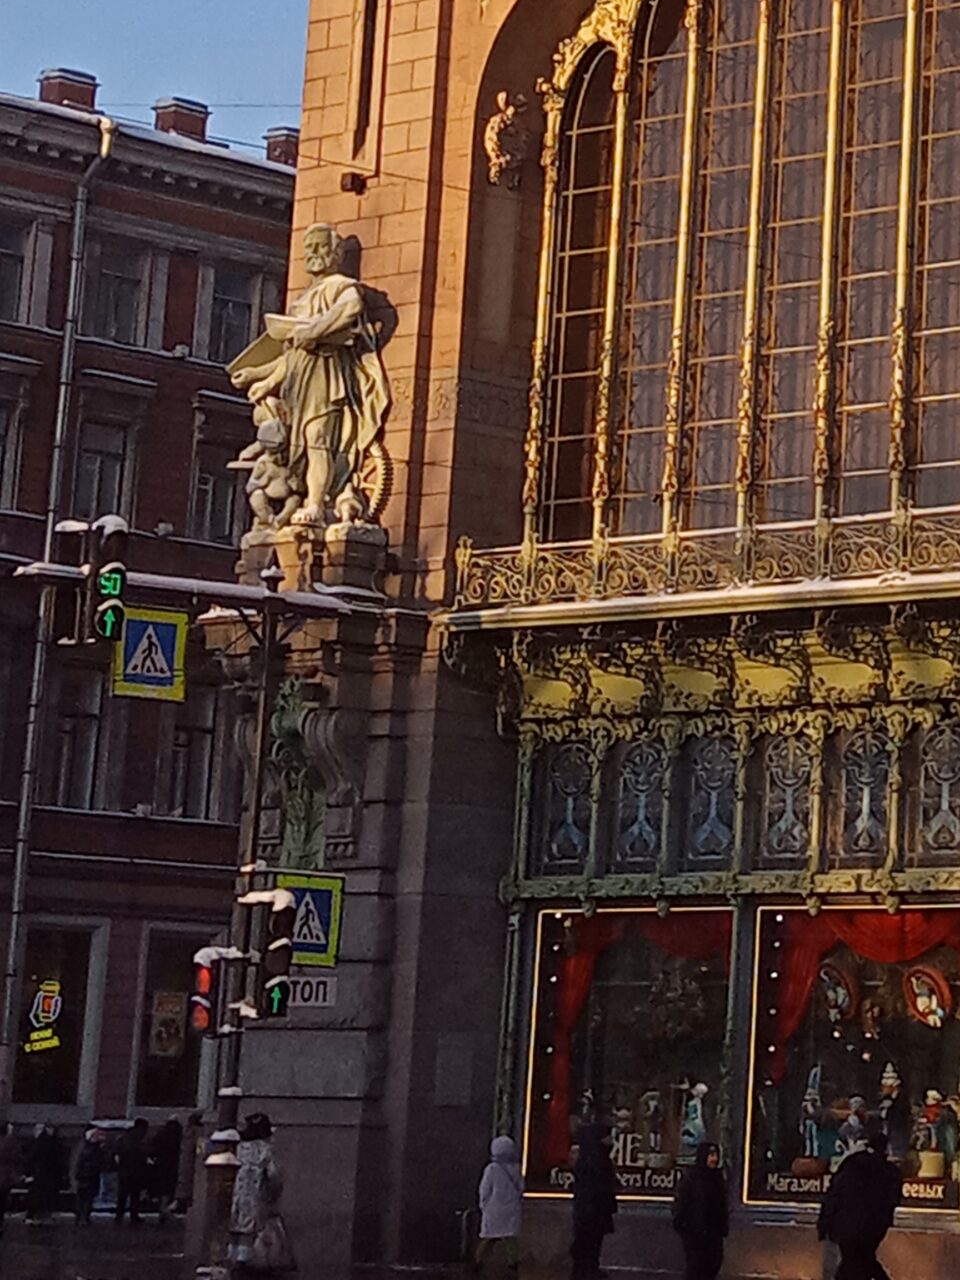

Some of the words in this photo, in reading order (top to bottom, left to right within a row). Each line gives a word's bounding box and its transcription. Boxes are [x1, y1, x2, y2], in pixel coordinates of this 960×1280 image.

[290, 980, 328, 1003] ТОП
[767, 1173, 821, 1193] Магазин
[902, 1181, 945, 1199] еевых
